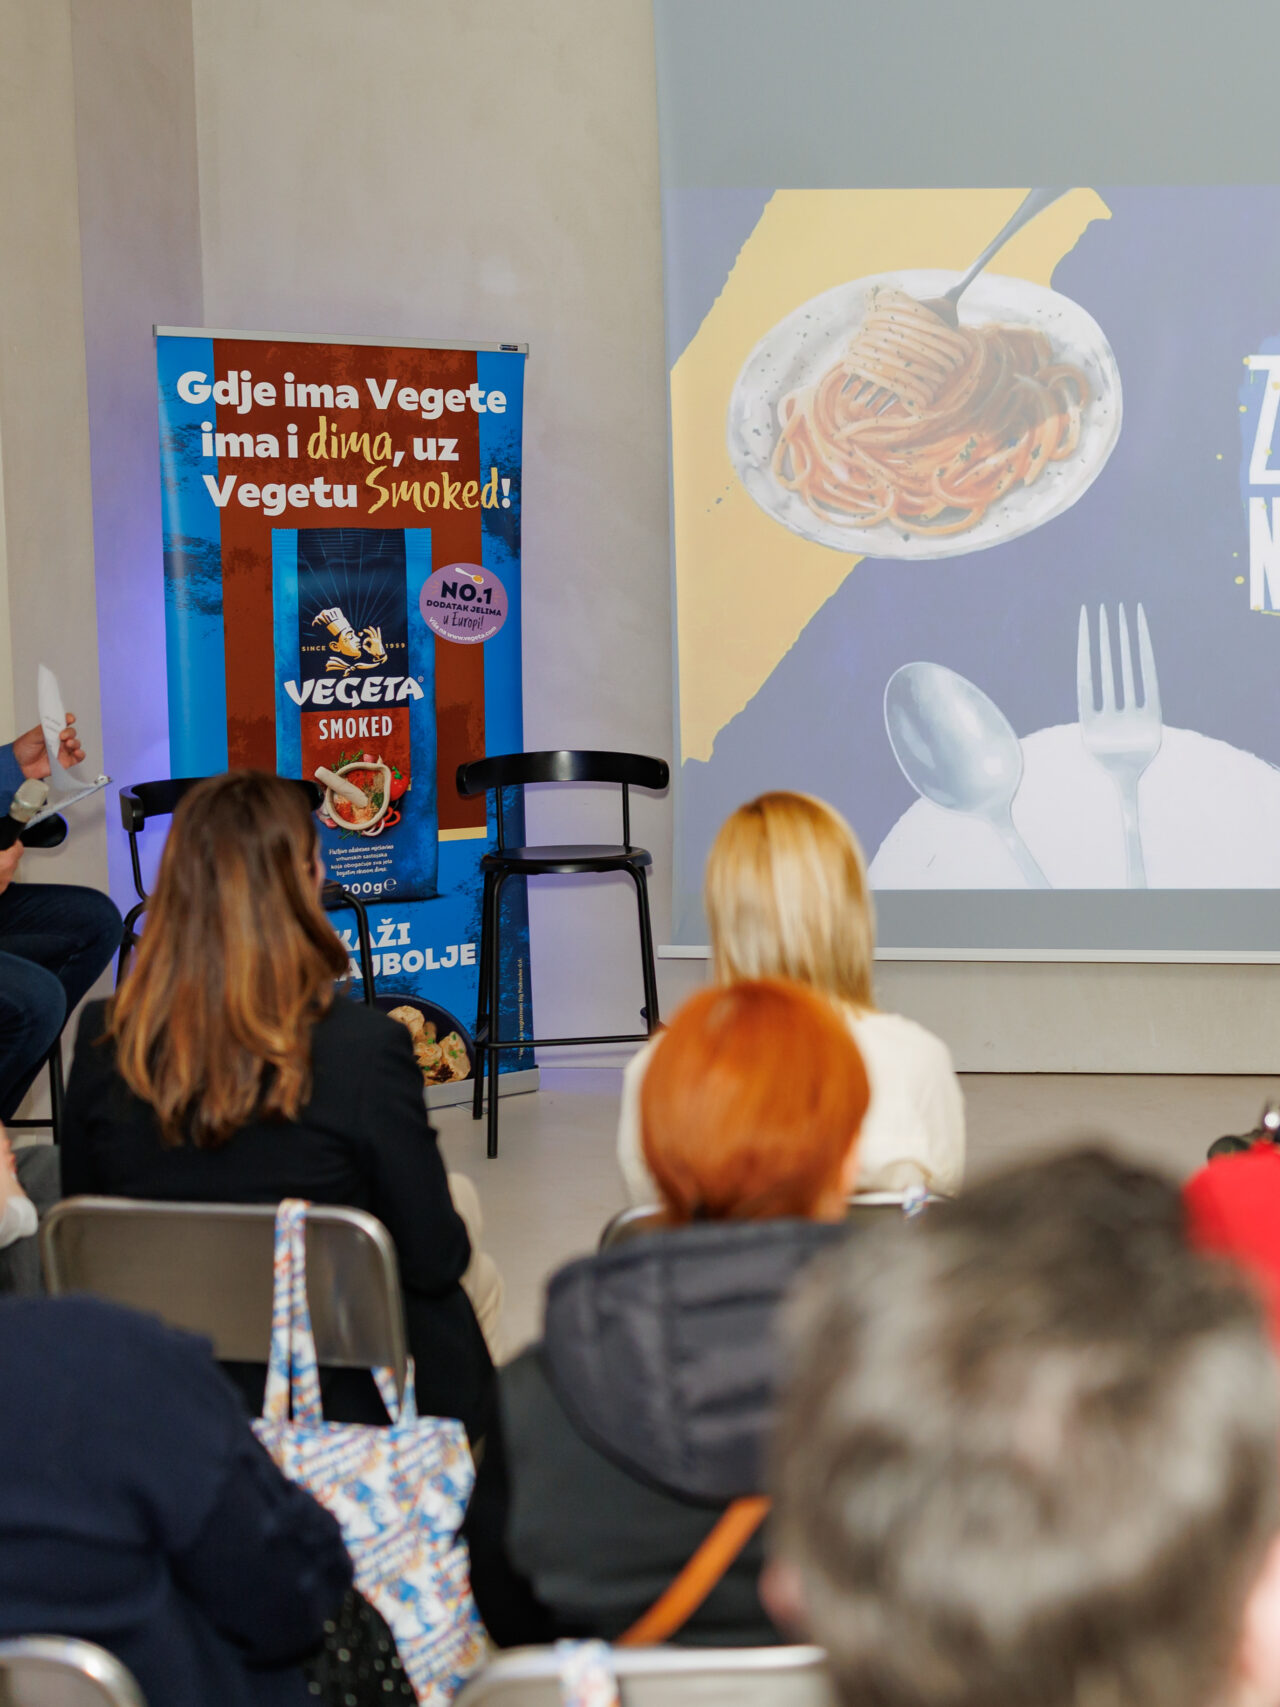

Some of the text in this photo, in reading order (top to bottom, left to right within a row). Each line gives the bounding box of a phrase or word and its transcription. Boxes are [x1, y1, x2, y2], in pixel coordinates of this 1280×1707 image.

[177, 370, 507, 419] Gdje ima Vegete
[201, 416, 459, 467] ima i dima, uz
[202, 465, 511, 516] Vegetu Smoked!
[426, 600, 502, 616] DODATAK JELIMA
[441, 580, 492, 605] NO.1
[443, 615, 449, 625] u
[284, 676, 424, 708] VEGETA
[318, 715, 393, 740] SMOKED
[334, 943, 476, 982] AJBOLJE
